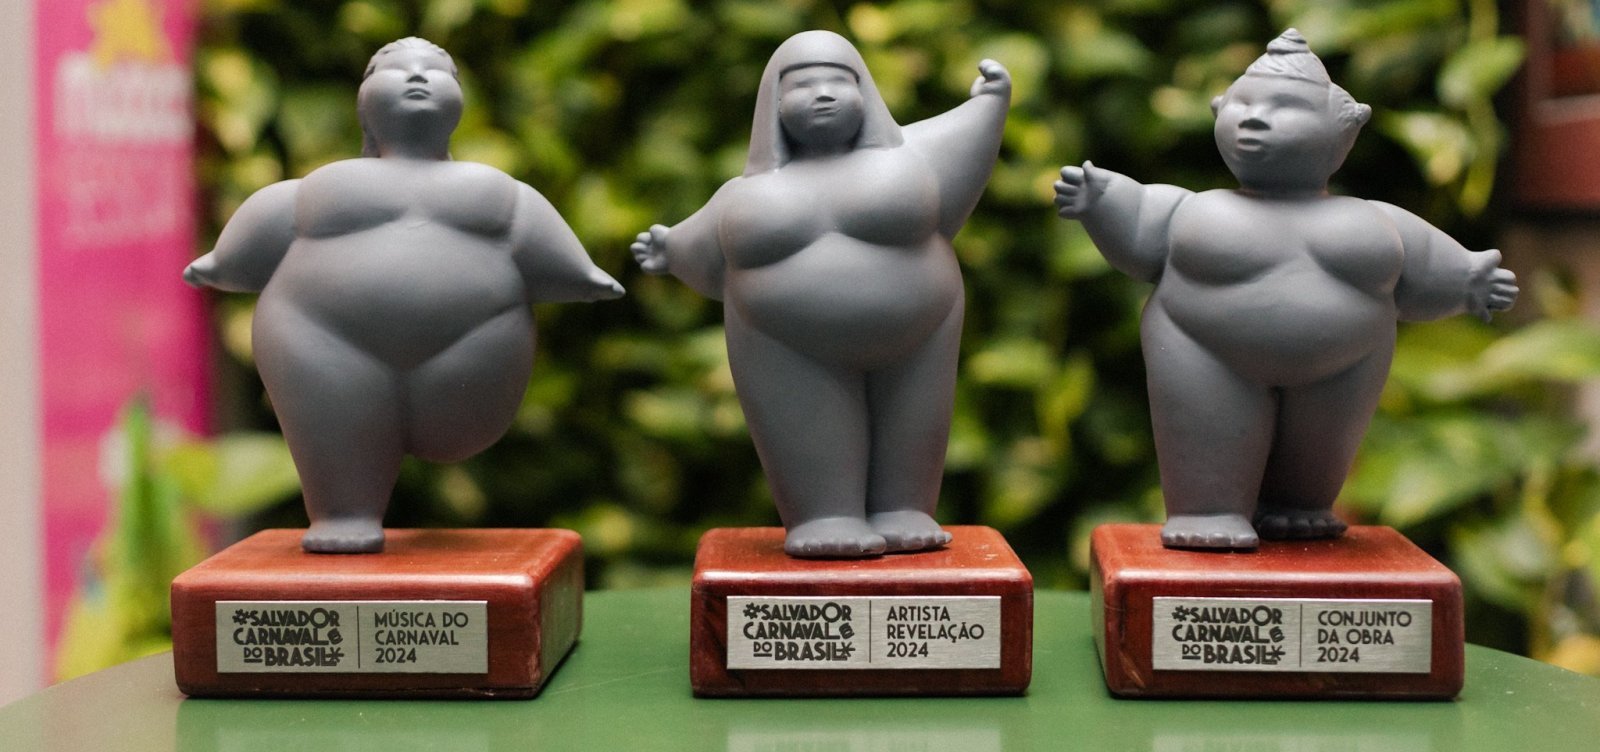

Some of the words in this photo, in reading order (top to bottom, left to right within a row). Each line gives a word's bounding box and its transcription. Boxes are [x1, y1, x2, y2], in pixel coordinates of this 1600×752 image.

[250, 607, 340, 629] SALVADOR
[374, 609, 436, 628] MÚSICA
[442, 612, 469, 628] DO
[762, 602, 851, 623] SALVADOR
[887, 606, 950, 622] ARTISTA
[1190, 605, 1283, 626] SALVADOR
[1318, 610, 1412, 627] CONJUNTO
[233, 628, 329, 646] CARNAVAL
[375, 630, 459, 646] CARNAVAL
[743, 622, 840, 640] CARNAVAL
[887, 622, 984, 643] REVELAÇÃO
[1172, 625, 1270, 643] CARNAVAL
[1318, 629, 1340, 644] DA
[1346, 629, 1394, 645] OBRA
[244, 647, 263, 659] DO
[265, 647, 337, 667] BRASIL
[375, 648, 417, 663] 2024
[753, 642, 772, 653] DO
[775, 642, 848, 661] BRASIL
[887, 642, 929, 658] 2024
[1182, 644, 1201, 655] DO
[1203, 644, 1278, 665] BRASIL
[1317, 647, 1360, 663] 2024
